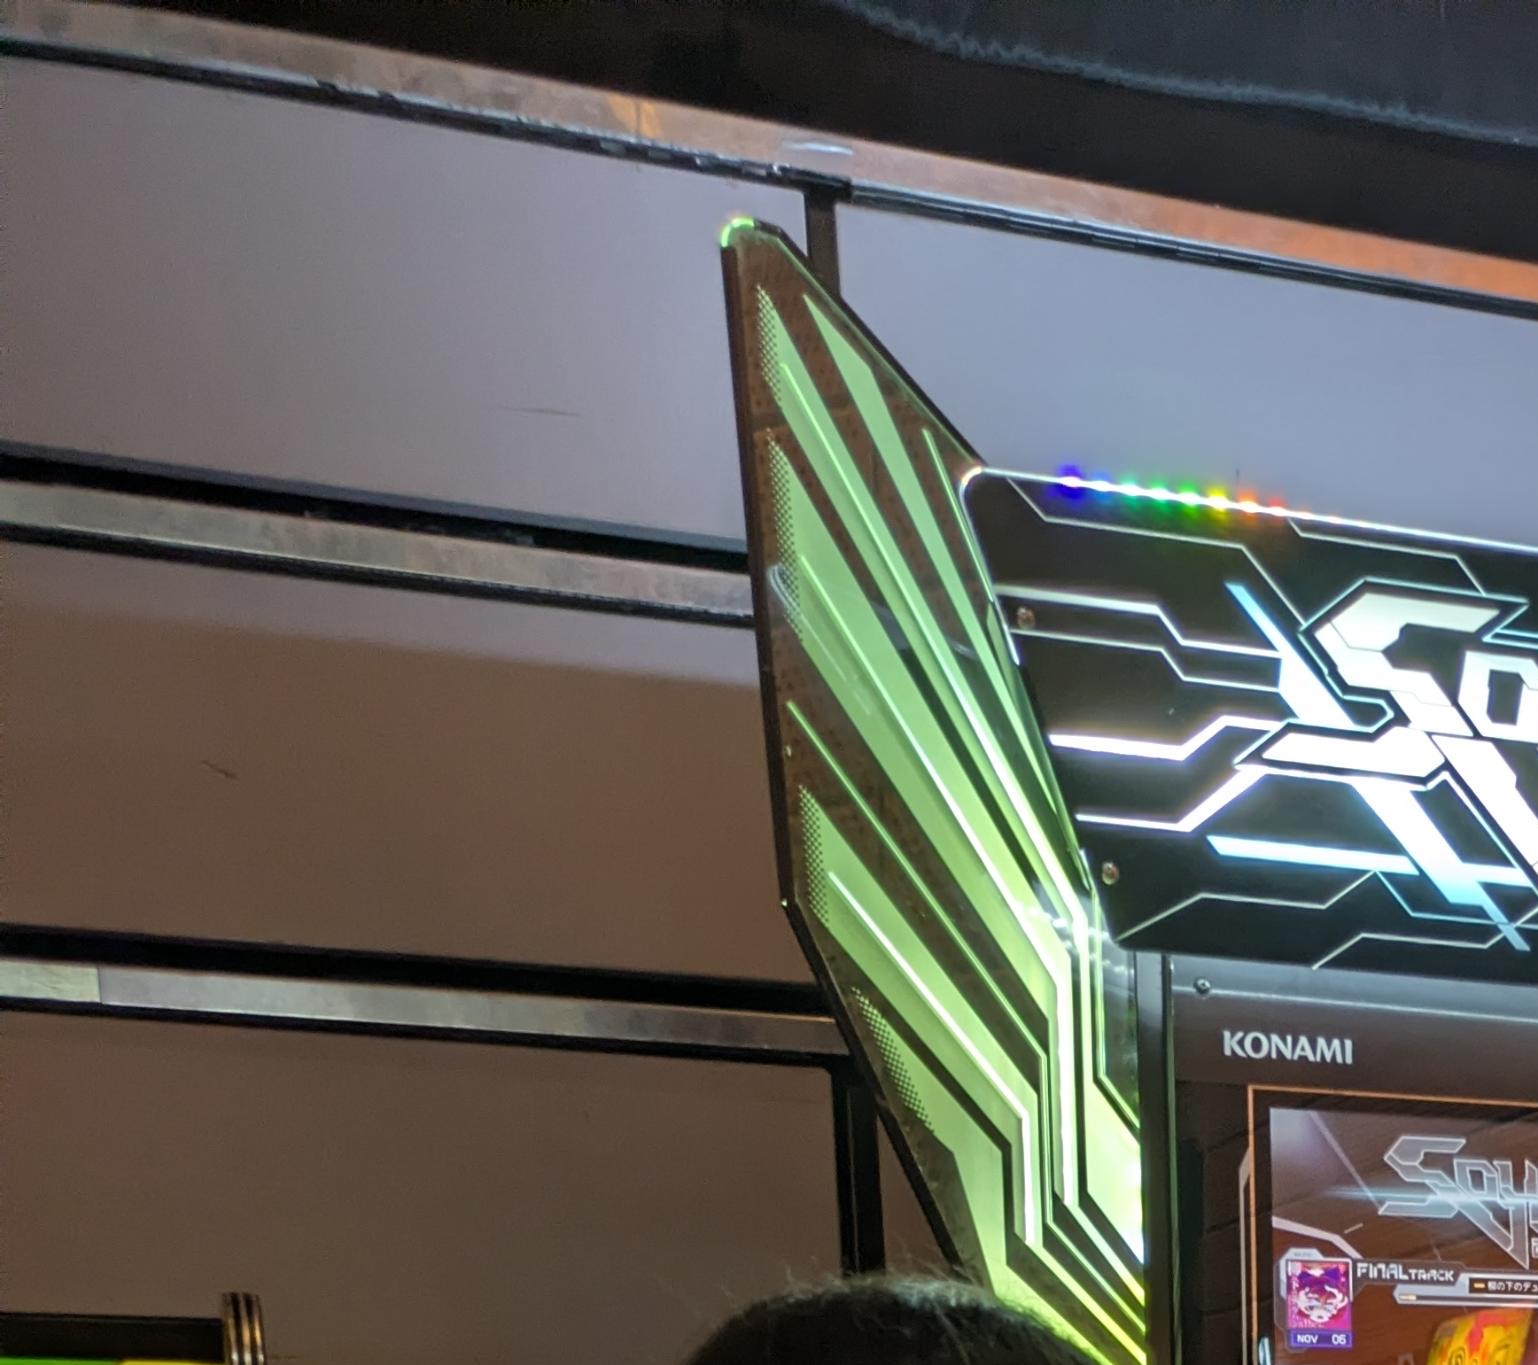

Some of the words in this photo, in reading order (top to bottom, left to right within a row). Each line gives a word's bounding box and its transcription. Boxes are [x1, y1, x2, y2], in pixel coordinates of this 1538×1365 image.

[1222, 1030, 1354, 1065] KONAMI
[1296, 1334, 1319, 1344] NOV
[1331, 1333, 1347, 1345] 06
